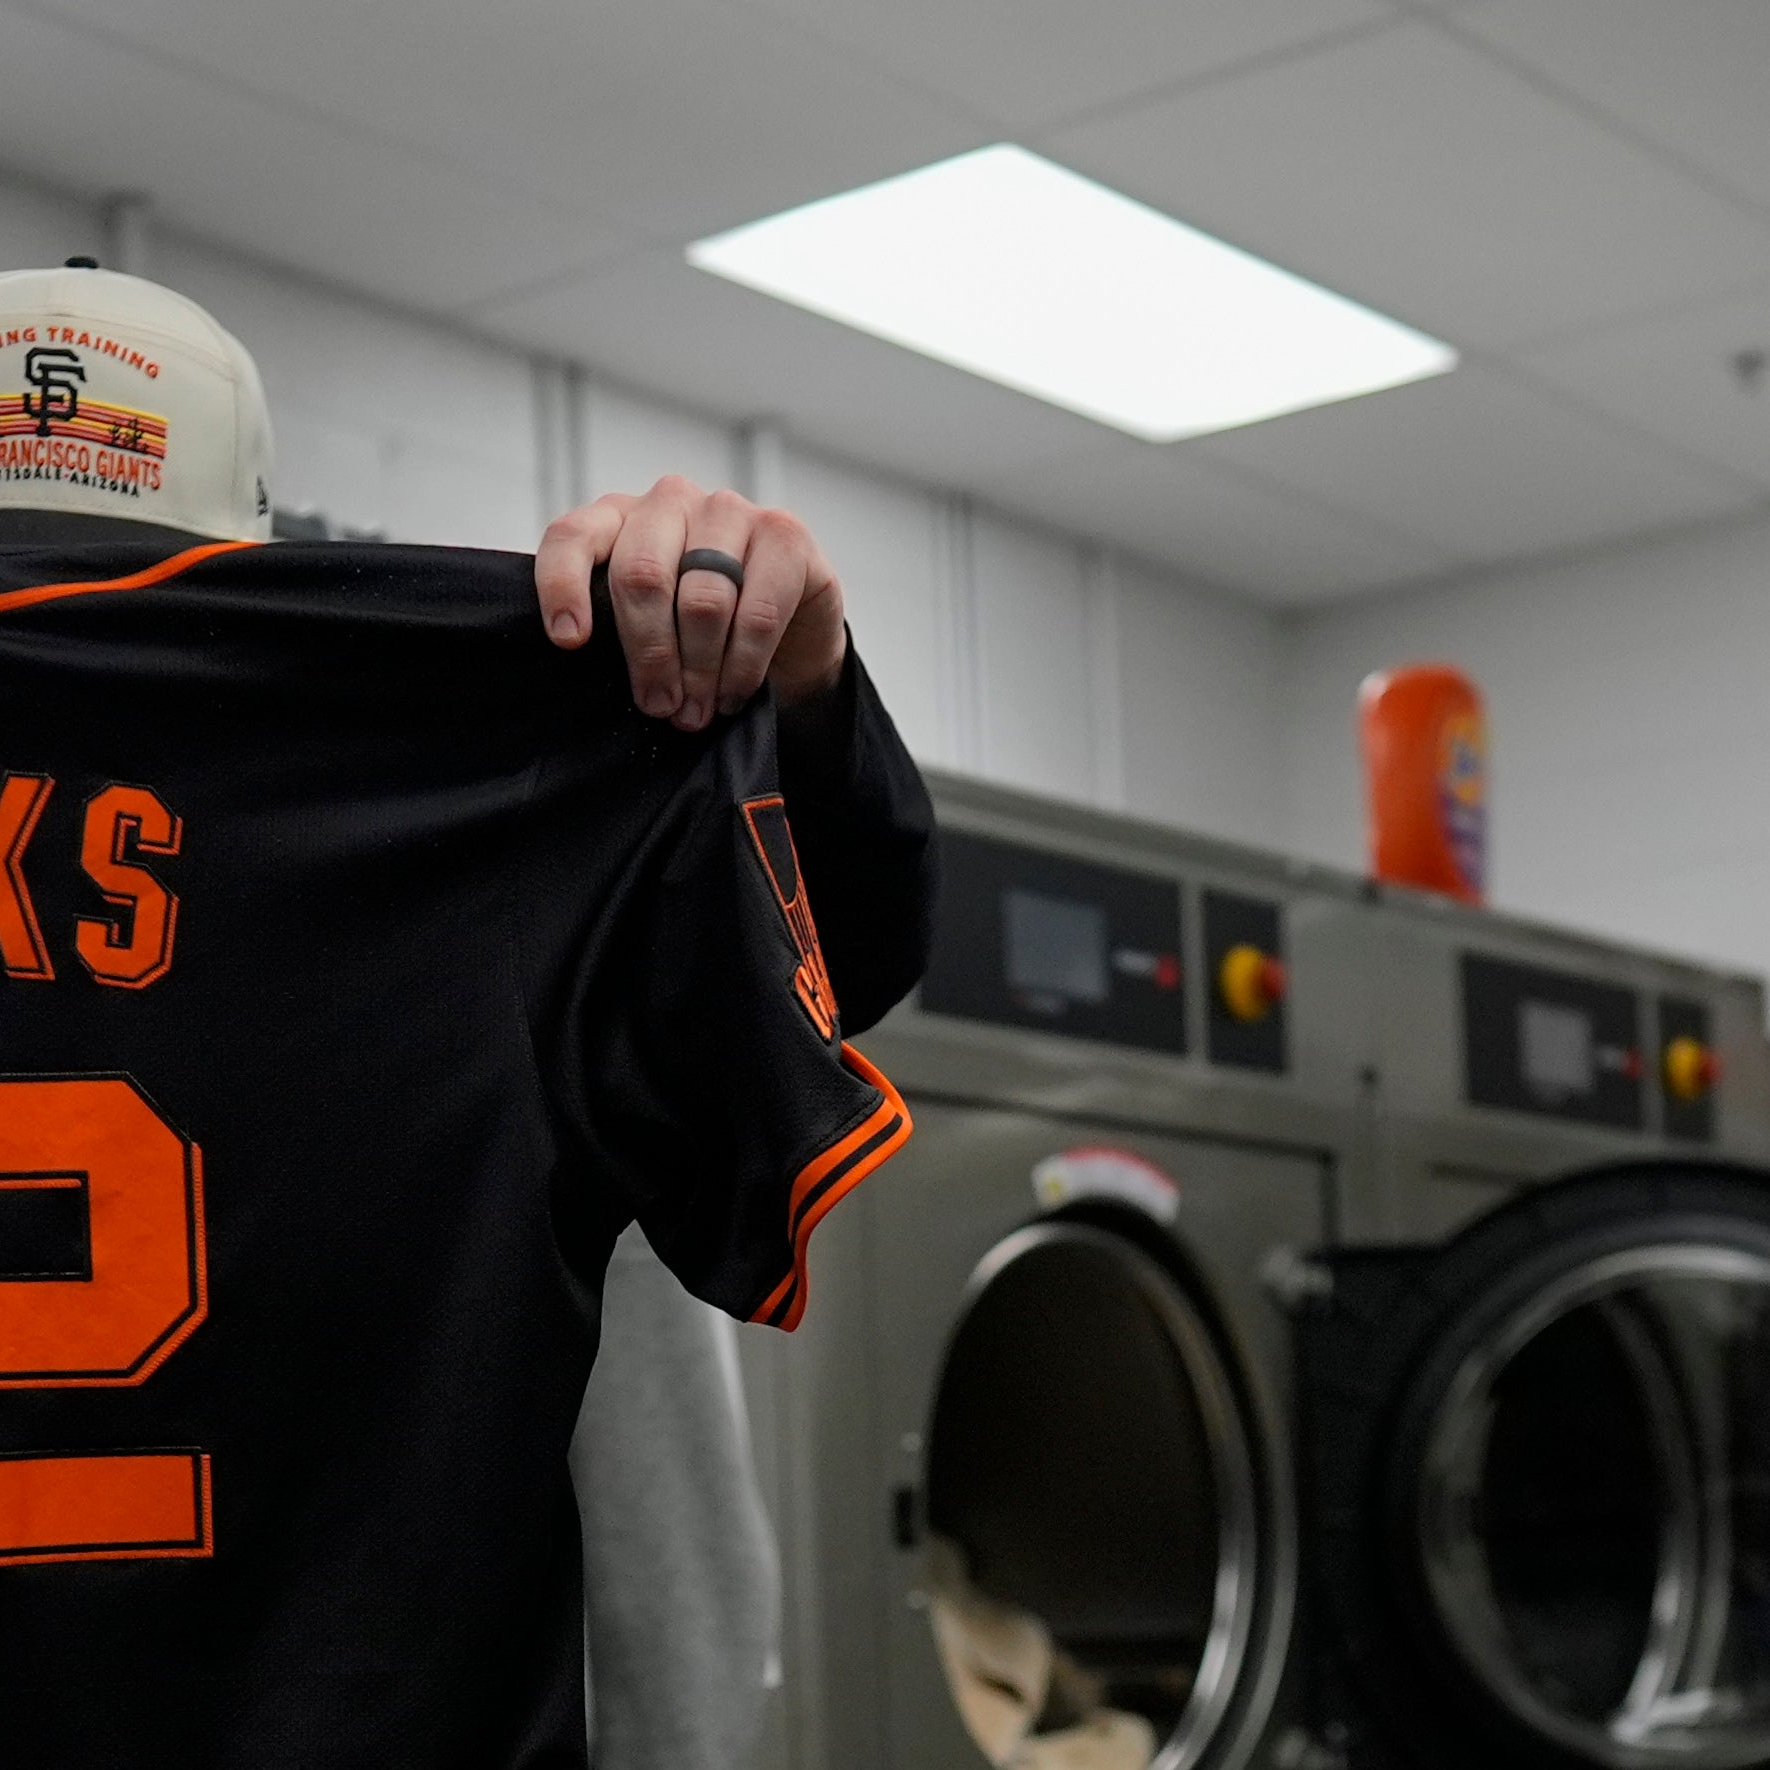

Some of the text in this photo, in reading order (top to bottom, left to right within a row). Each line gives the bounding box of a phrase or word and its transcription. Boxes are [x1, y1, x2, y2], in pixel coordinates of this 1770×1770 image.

[47, 326, 161, 380] TRAINING
[22, 346, 87, 437] SF
[96, 450, 163, 491] GIANTS
